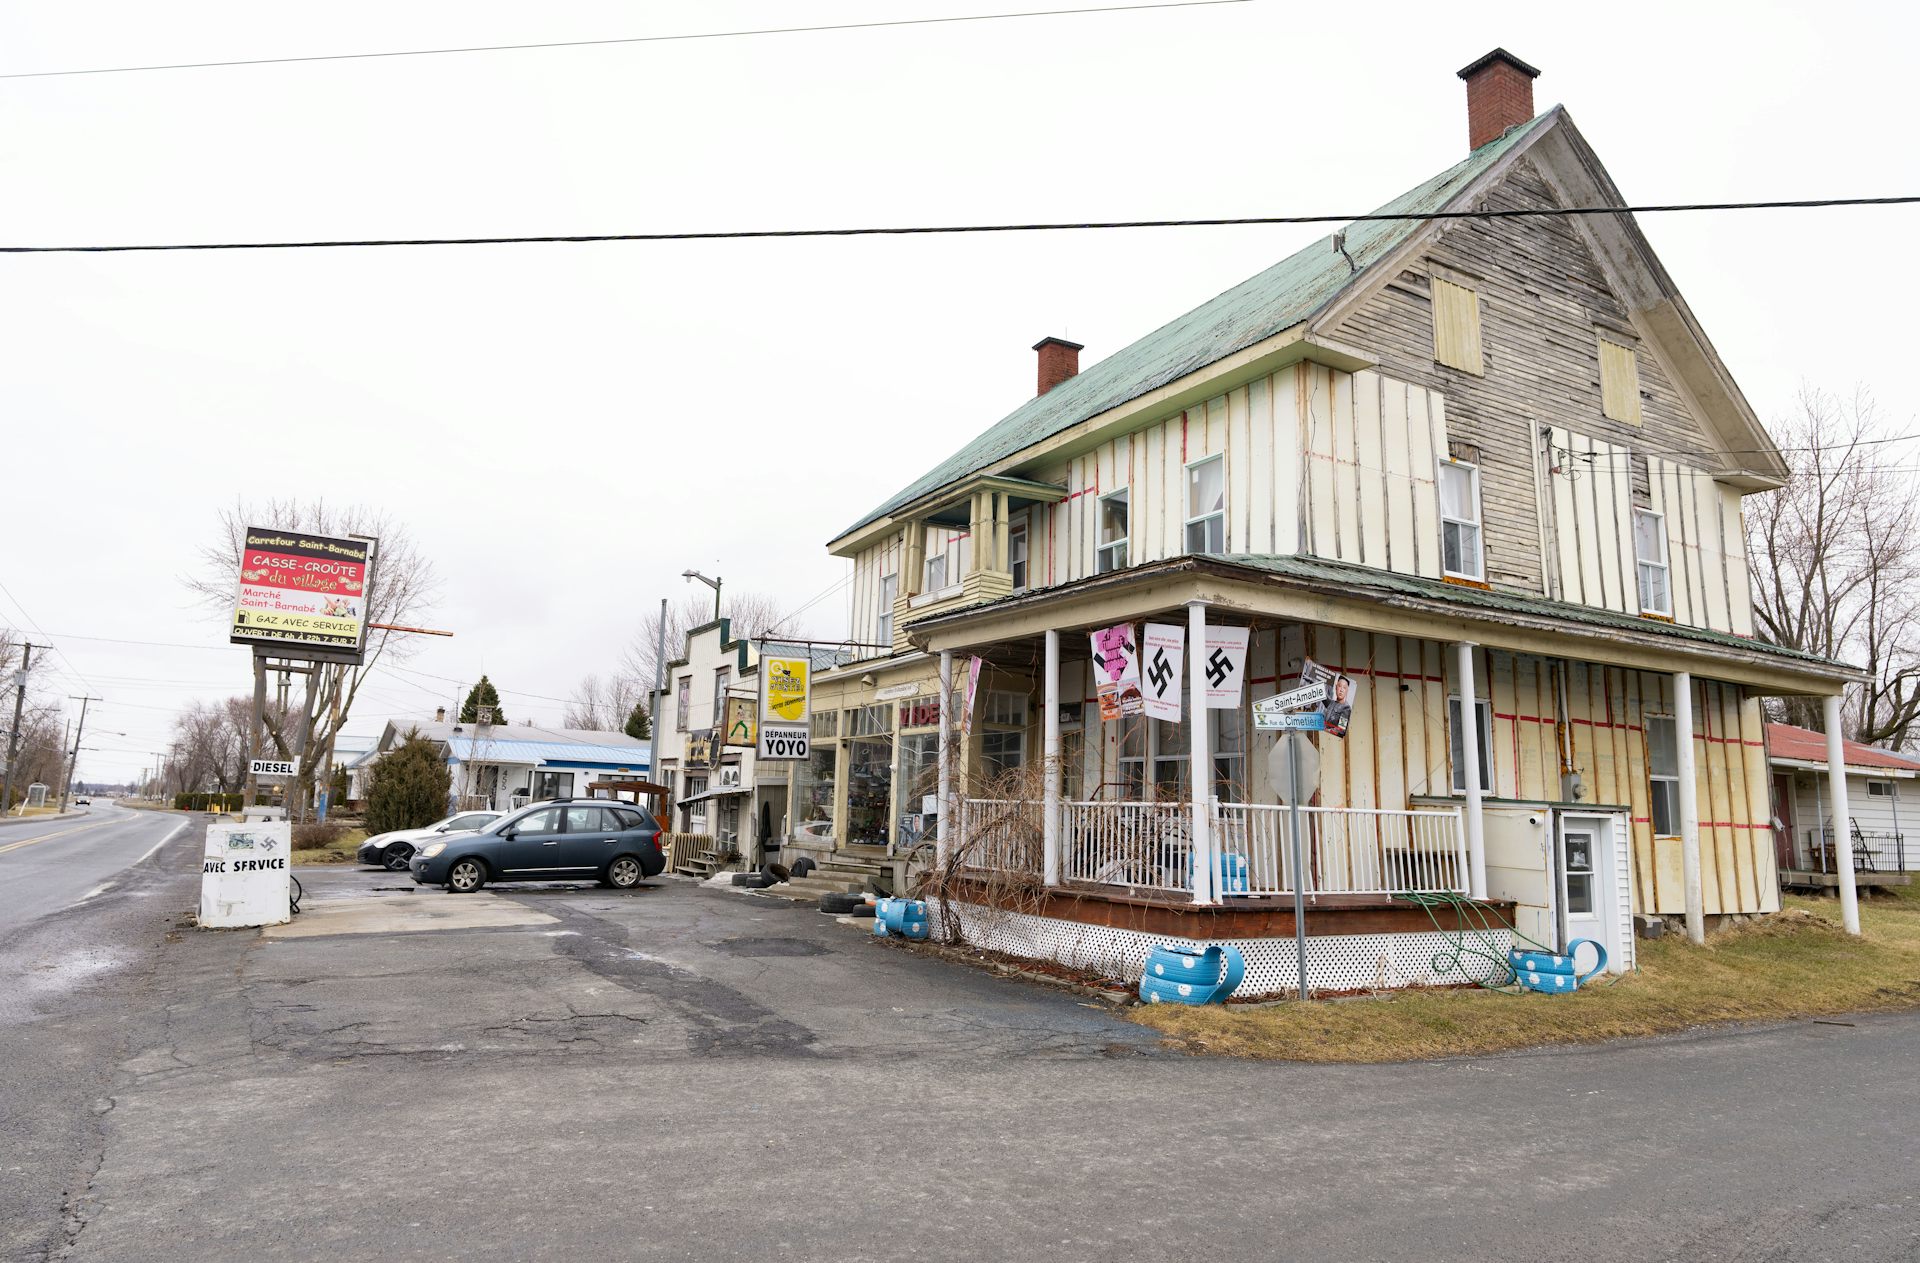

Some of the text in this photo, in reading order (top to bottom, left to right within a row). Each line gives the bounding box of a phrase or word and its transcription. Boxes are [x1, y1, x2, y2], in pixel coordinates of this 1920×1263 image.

[248, 536, 366, 559] Carrefour Saint-Barnabé
[252, 556, 357, 577] CASSE-CROÛTE
[269, 570, 338, 592] du village
[243, 588, 281, 600] Marché
[241, 598, 316, 613] Saint-Barnabé
[256, 616, 356, 633] GAZ AVEC SERVICE
[234, 628, 269, 638] OUVERT
[270, 631, 282, 639] DE
[284, 632, 295, 640] 6h
[306, 634, 320, 642] 22h
[330, 637, 348, 645] SUR
[349, 638, 356, 646] 7
[1274, 688, 1324, 710] Saint-Amable
[900, 703, 940, 727] VIDE
[1285, 716, 1322, 726] Cimetière
[765, 728, 807, 740] DÉPANNEUR
[766, 740, 806, 756] YOYO
[253, 762, 293, 774] DIESEL
[204, 862, 226, 874] AVEC
